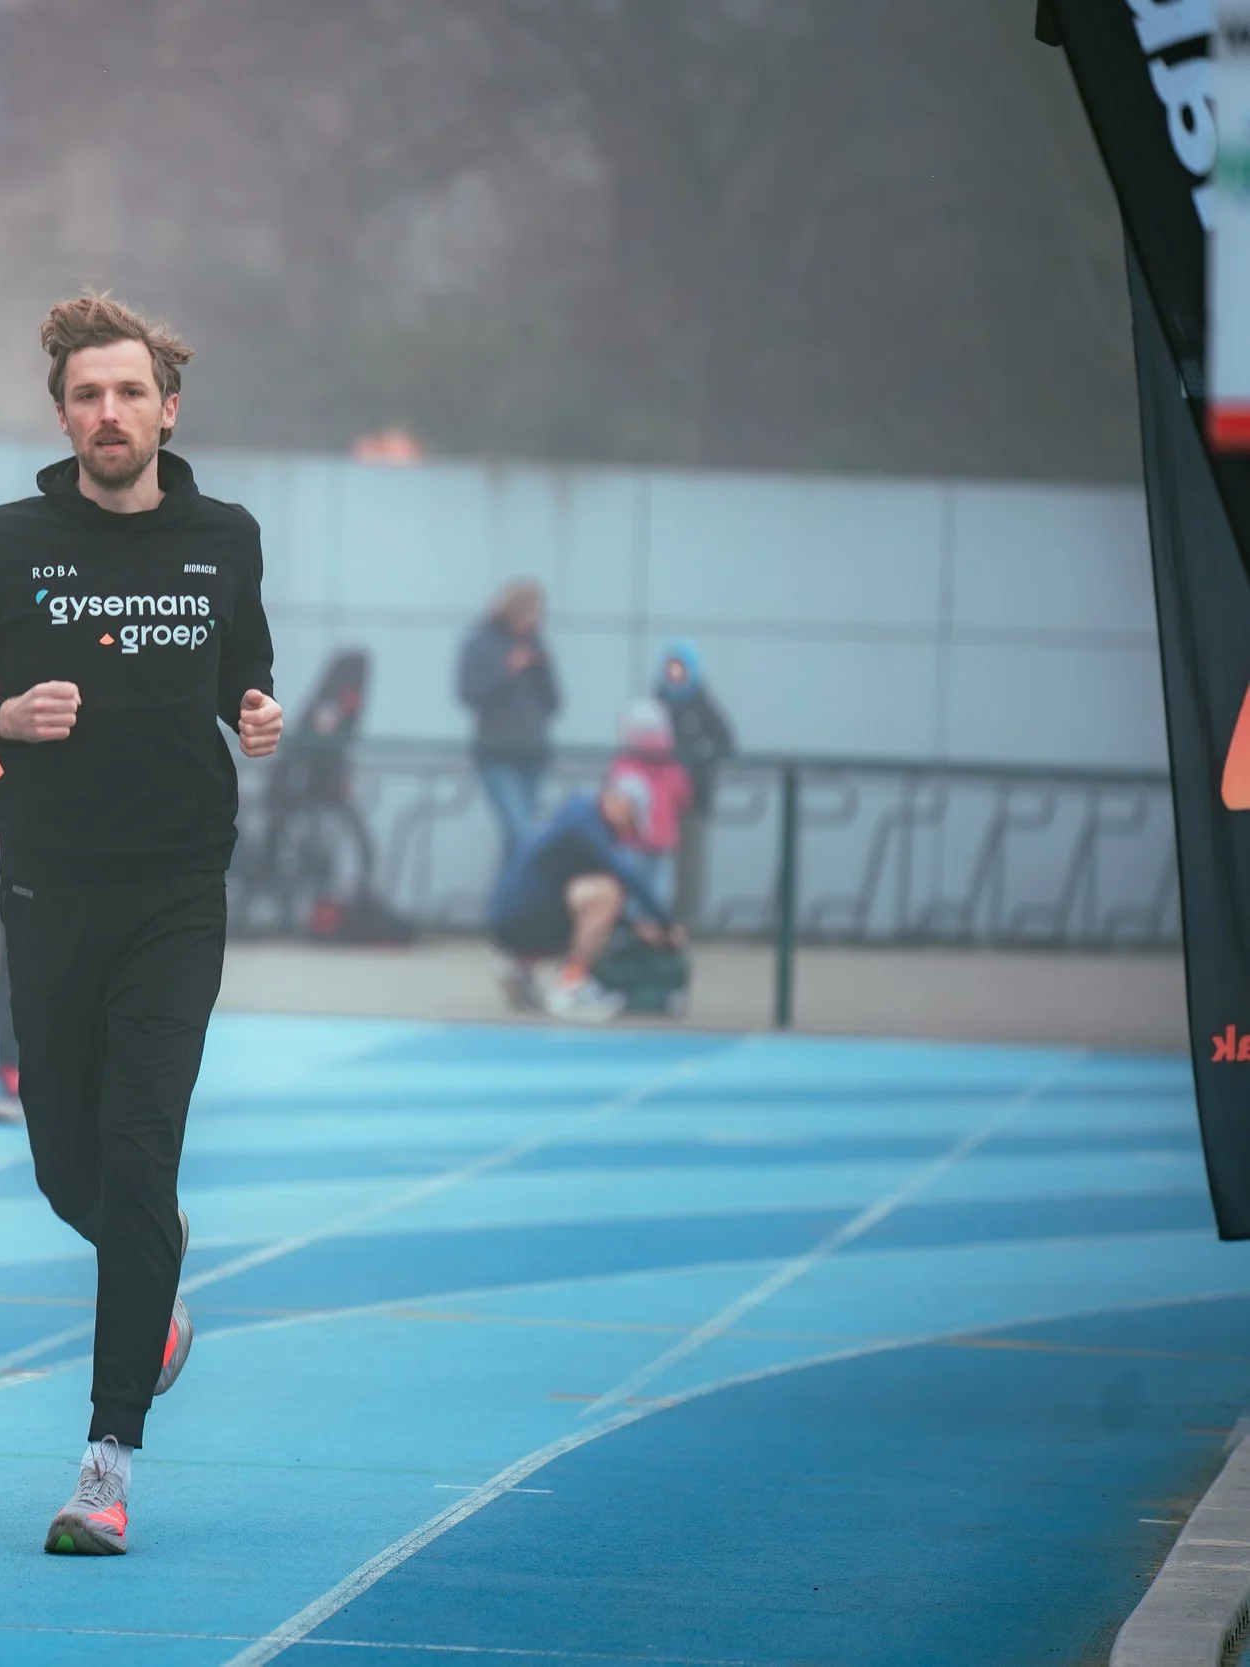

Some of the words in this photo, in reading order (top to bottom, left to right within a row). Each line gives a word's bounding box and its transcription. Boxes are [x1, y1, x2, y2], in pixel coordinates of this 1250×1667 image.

[32, 565, 78, 579] ROBA
[183, 563, 217, 575] BIORACER
[49, 595, 210, 625] gysemans
[120, 625, 208, 654] groep
